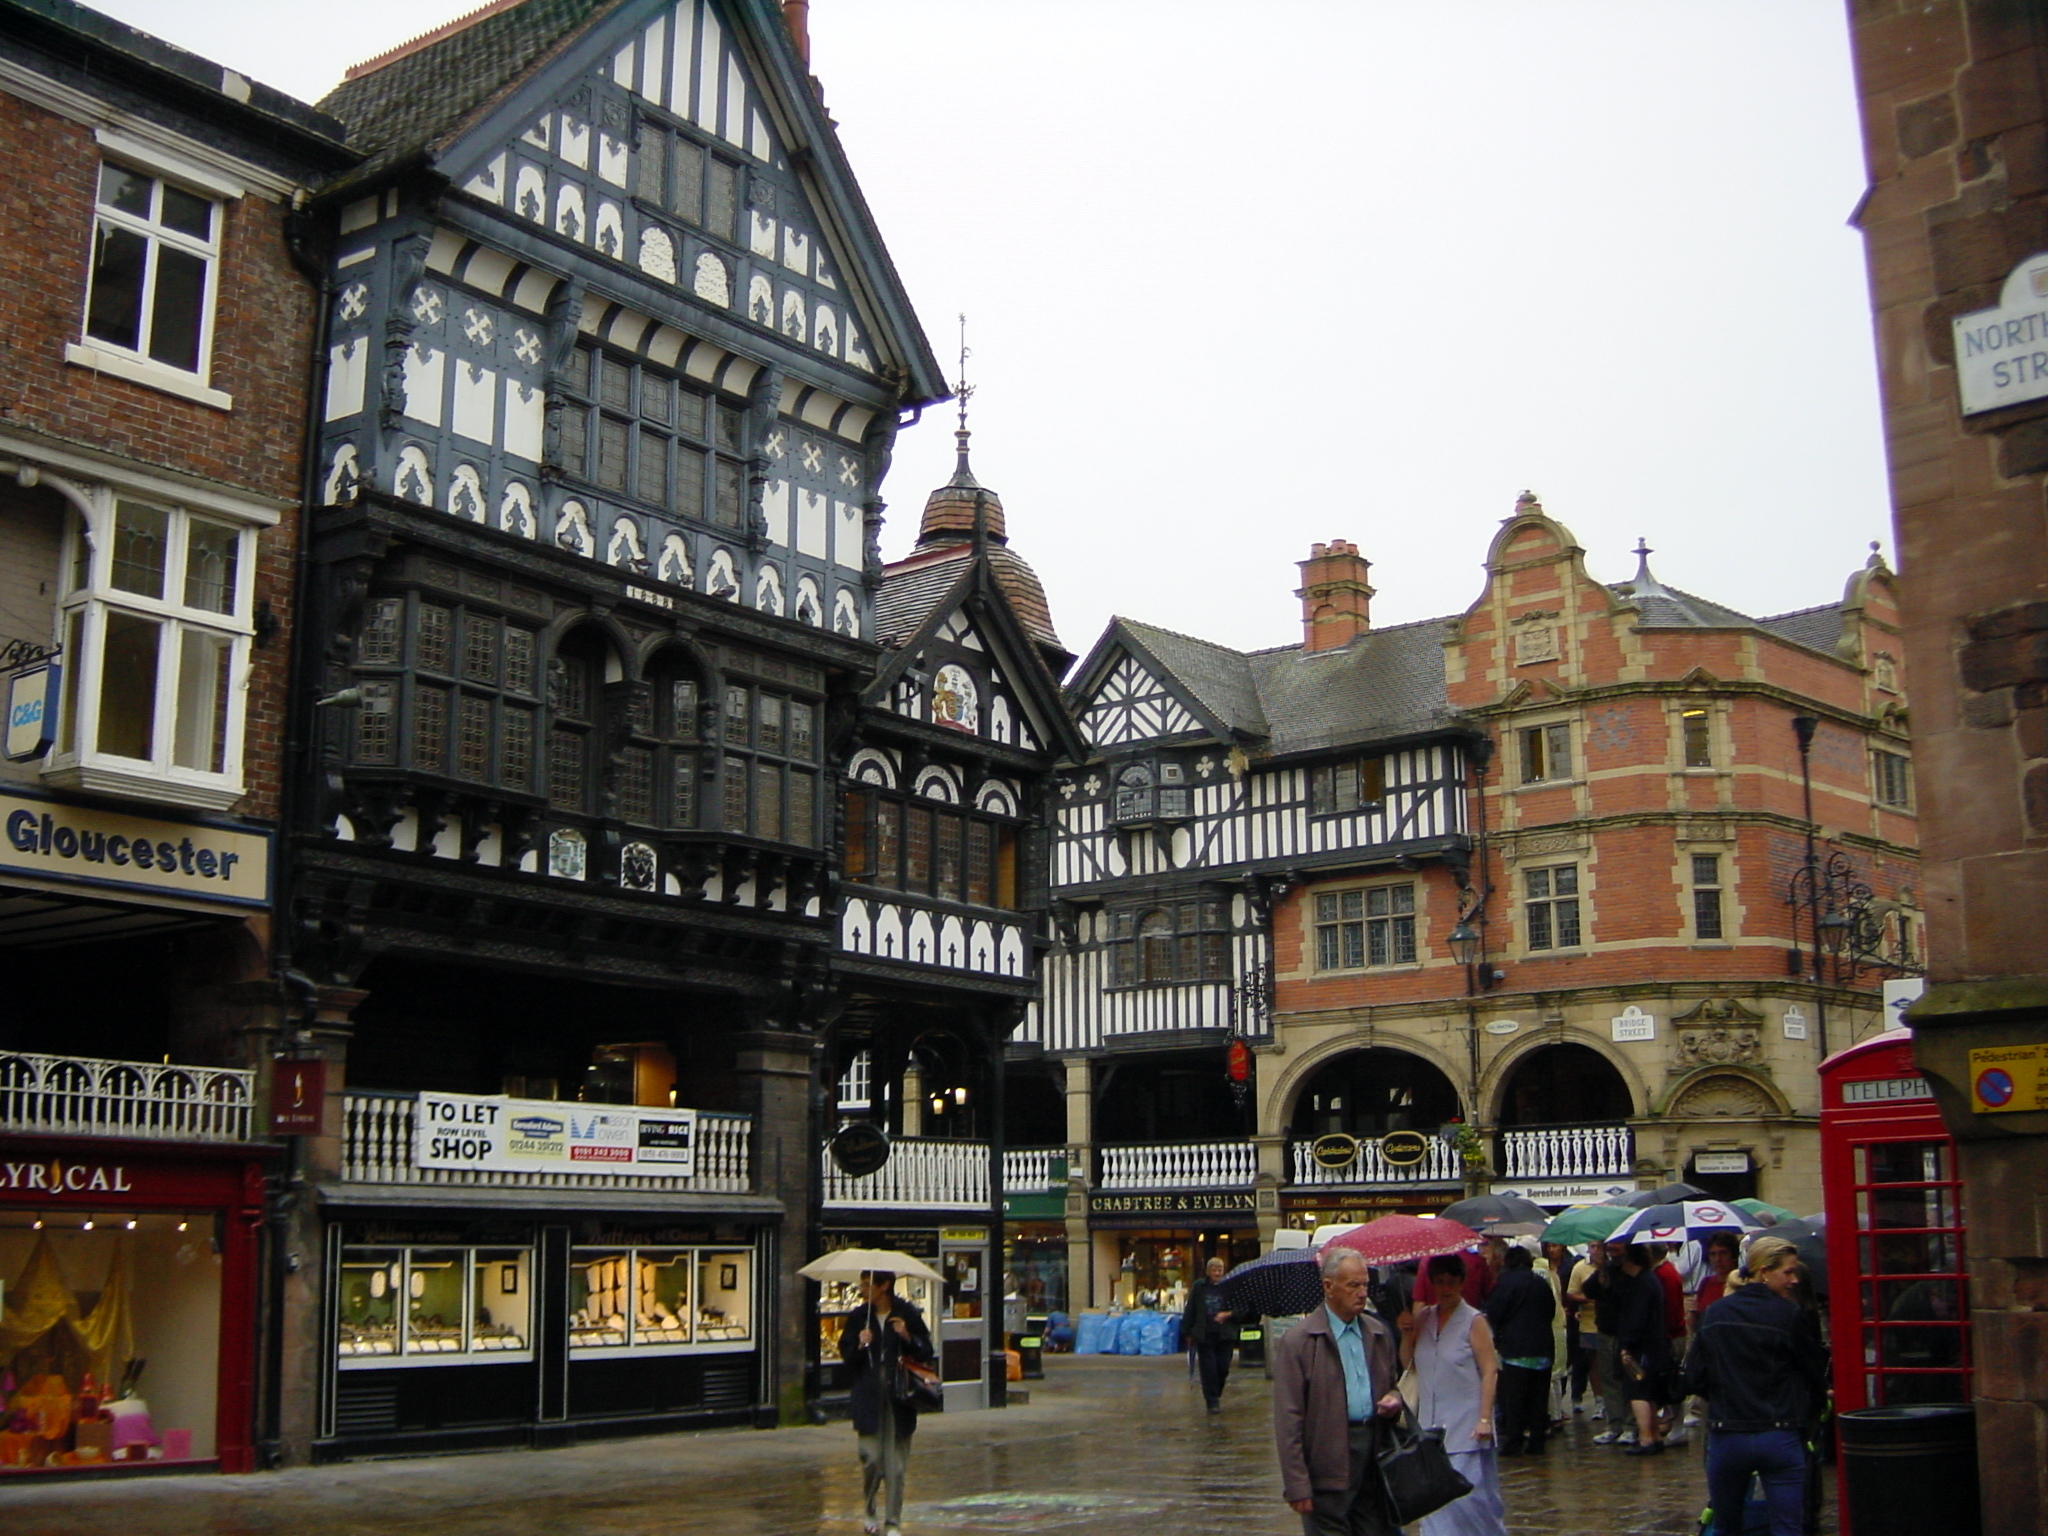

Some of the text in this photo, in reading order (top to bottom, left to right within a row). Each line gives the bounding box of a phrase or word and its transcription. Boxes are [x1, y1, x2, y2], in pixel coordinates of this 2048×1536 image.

[12, 700, 42, 728] C&G
[6, 809, 238, 881] Gloucester
[1618, 1018, 1646, 1027] BRIDGE
[1618, 1028, 1647, 1036] STREET
[1973, 1051, 2036, 1063] Pedestrian
[1846, 1079, 1927, 1101] TELEPH
[427, 1102, 499, 1124] TO LET
[437, 1127, 486, 1138] ROW LEVEL
[430, 1138, 492, 1160] SHOP
[0, 1159, 131, 1194] YRICAL
[1092, 1194, 1256, 1210] CRABTREE & EVELYN
[1527, 1187, 1598, 1198] Beresford Adams
